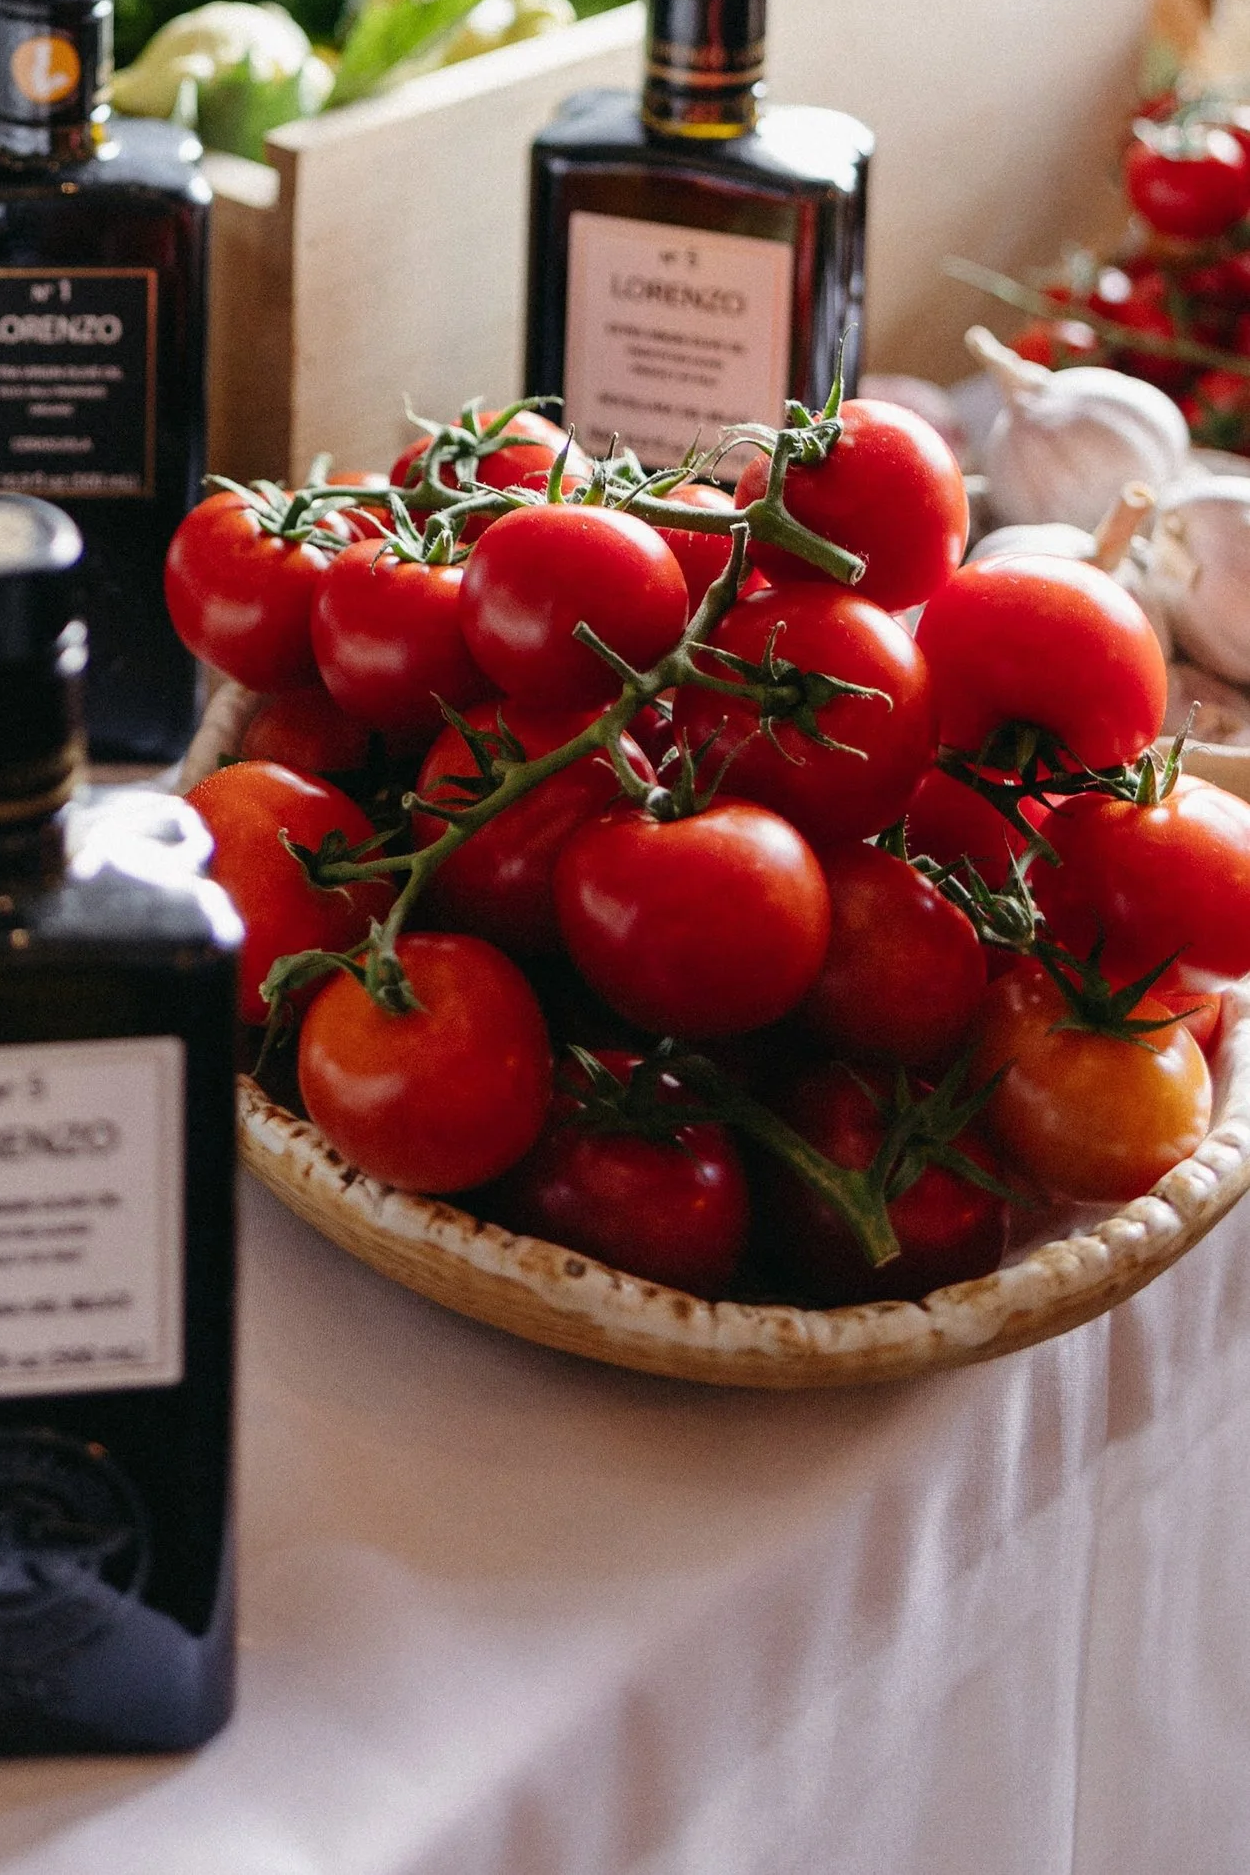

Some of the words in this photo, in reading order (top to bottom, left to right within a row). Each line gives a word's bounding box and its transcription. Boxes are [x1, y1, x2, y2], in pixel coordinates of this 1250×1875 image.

[32, 40, 70, 99] L
[58, 278, 72, 303] 1
[609, 273, 748, 316] LORENZO
